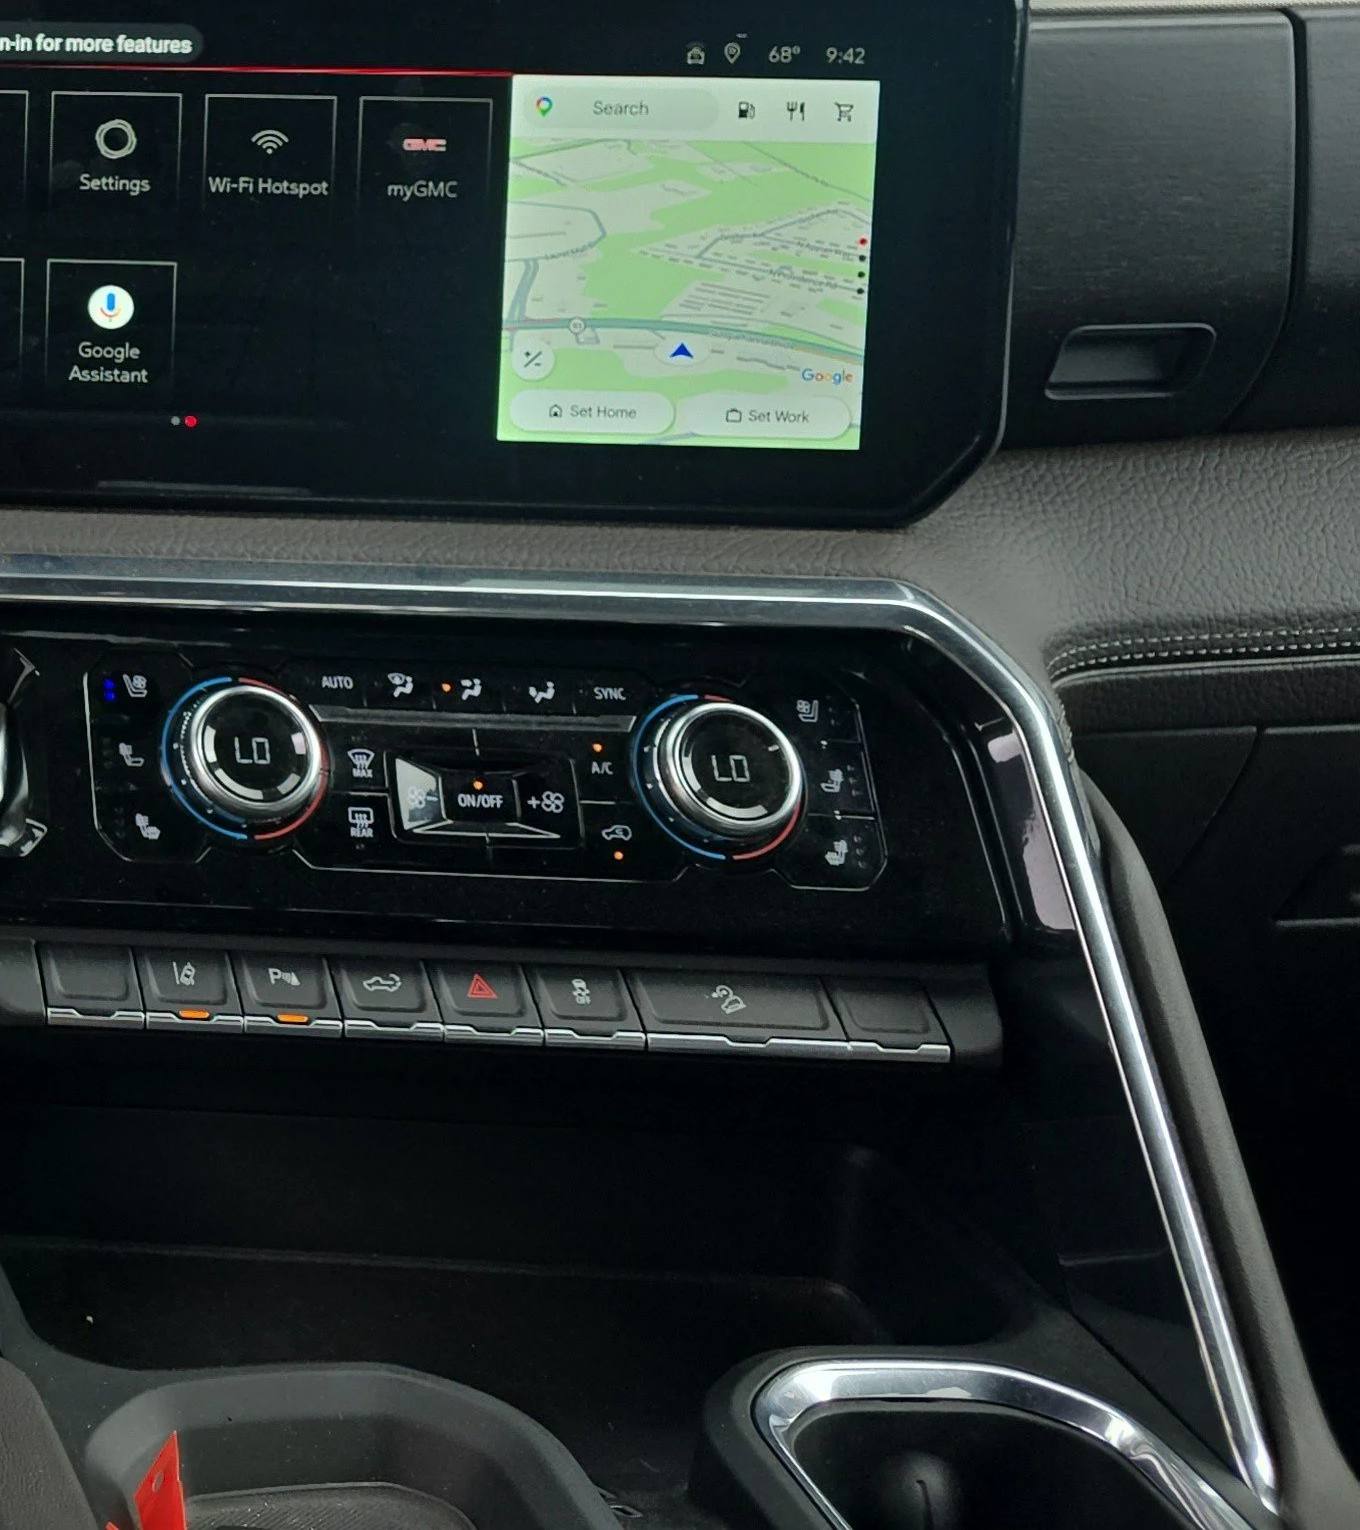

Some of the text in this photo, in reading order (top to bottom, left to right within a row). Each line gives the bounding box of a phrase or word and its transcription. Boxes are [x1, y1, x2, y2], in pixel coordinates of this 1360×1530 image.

[35, 33, 63, 52] for
[65, 38, 114, 53] more
[116, 34, 193, 54] features
[826, 47, 866, 65] 9:42
[593, 100, 650, 117] Search
[402, 138, 447, 152] GMC
[79, 174, 151, 196] Settings
[208, 176, 329, 199] Wi-Fi Hotspot
[387, 180, 458, 201] myGMC
[78, 342, 141, 363] Google
[69, 365, 148, 383] Assistant
[801, 368, 853, 386] Google
[569, 404, 636, 419] Set Home
[748, 409, 810, 424] Set Work
[321, 675, 354, 690] AUTO
[593, 686, 627, 701] SYNC
[352, 768, 373, 778] MAX
[591, 761, 614, 775] A/C
[457, 793, 504, 809] ON/OFF
[350, 825, 374, 838] REAR
